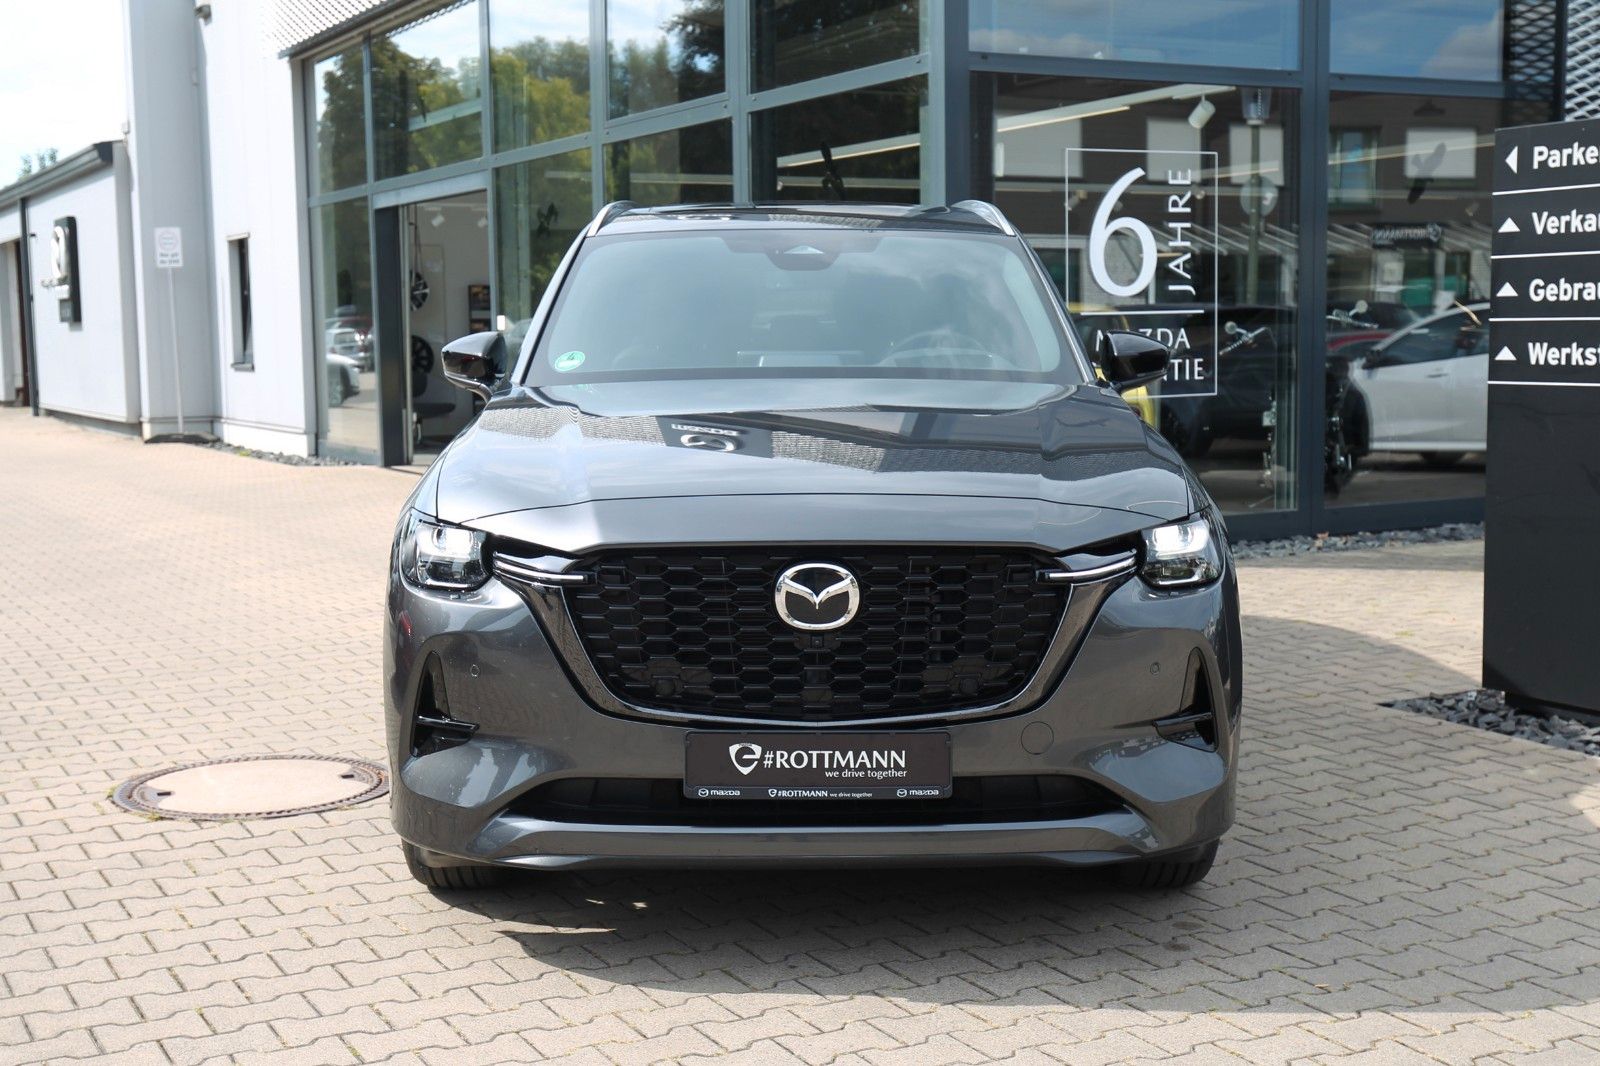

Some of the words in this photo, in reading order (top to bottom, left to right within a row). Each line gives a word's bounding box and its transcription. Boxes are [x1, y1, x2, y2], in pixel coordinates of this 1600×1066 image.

[1532, 141, 1600, 170] Parke
[1089, 166, 1158, 297] 6
[1168, 168, 1197, 296] JAHRE
[1531, 208, 1600, 235] Verka
[1528, 277, 1600, 302] Gebra
[763, 750, 906, 769] #ROTTMANN
[825, 770, 840, 778] we
[841, 768, 866, 778] drive
[867, 768, 908, 780] together
